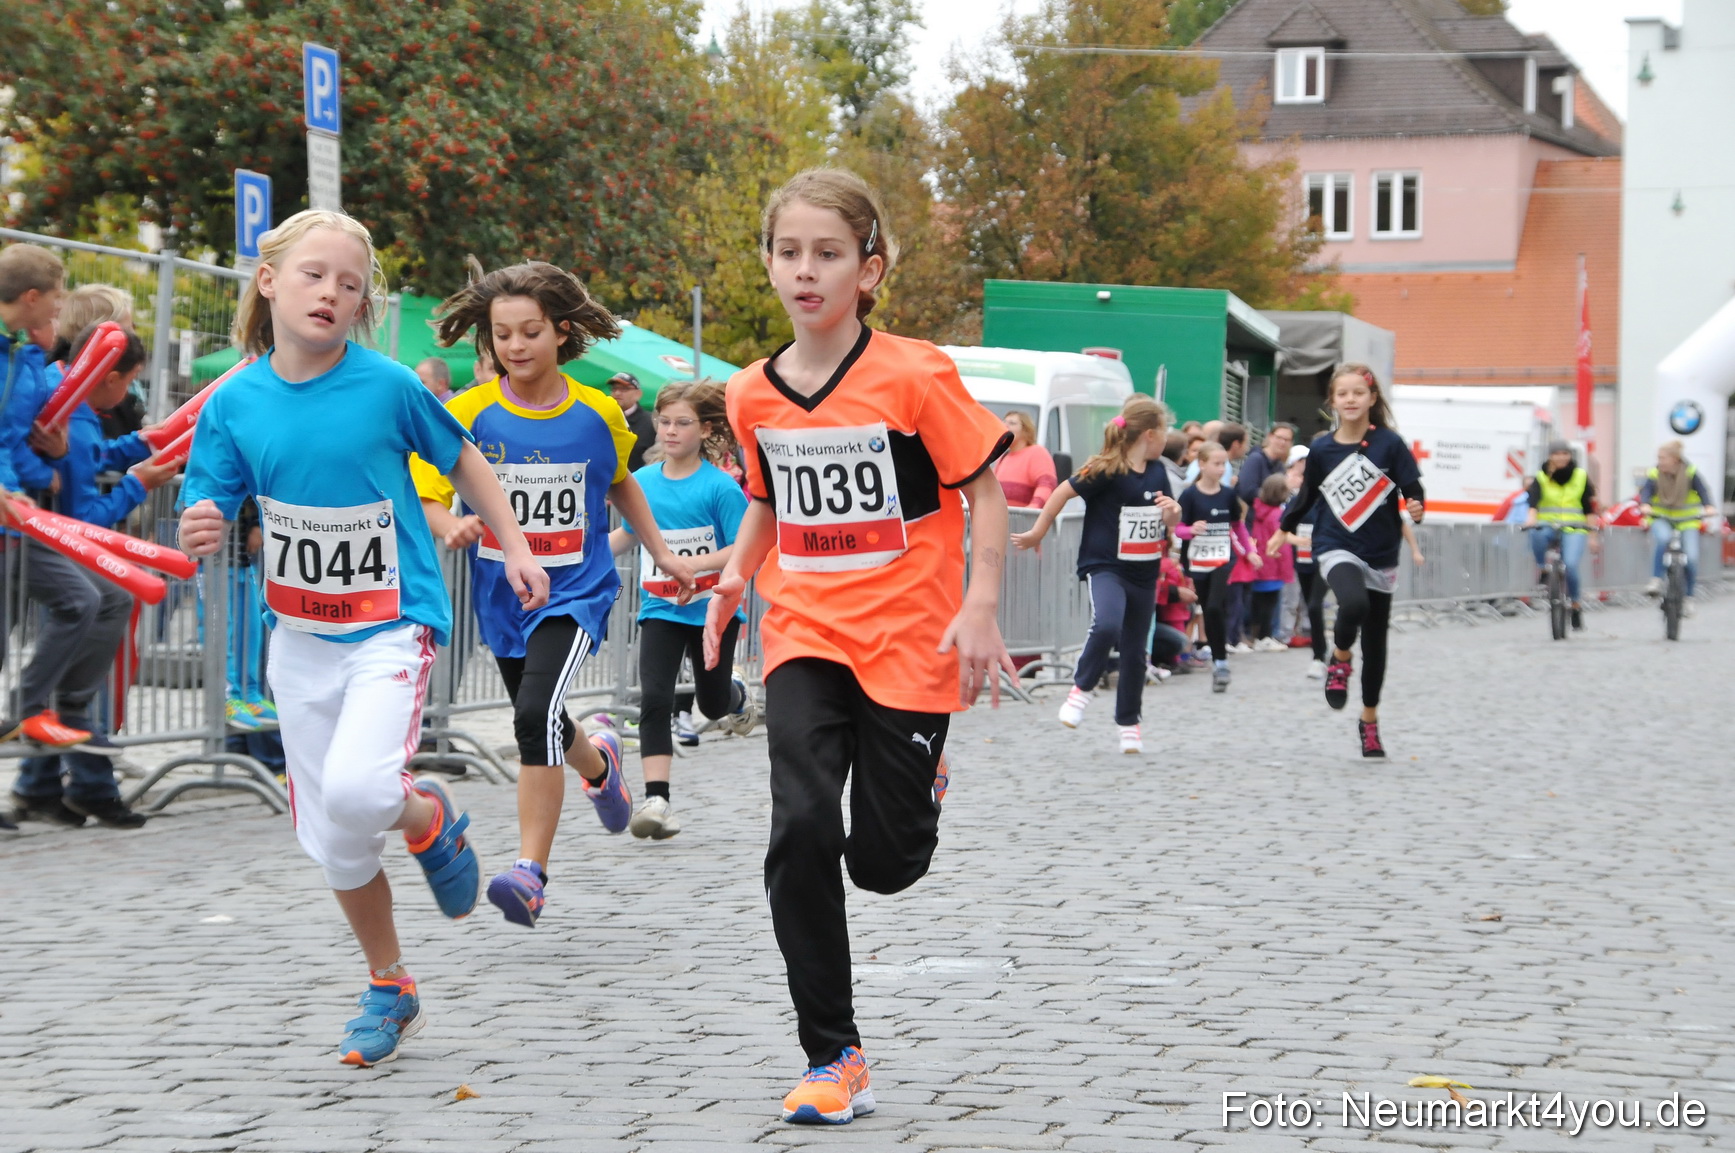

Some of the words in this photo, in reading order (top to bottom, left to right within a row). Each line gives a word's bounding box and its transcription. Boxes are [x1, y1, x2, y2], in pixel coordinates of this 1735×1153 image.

[312, 56, 333, 120] P
[243, 183, 264, 248] P
[763, 442, 793, 457] PARTL
[796, 442, 863, 457] Neumarkt
[515, 474, 567, 485] Neumarkt
[777, 461, 885, 517] 7039
[1332, 464, 1375, 510] 7554
[264, 506, 299, 530] PARTL
[302, 518, 371, 533] Neumarkt
[504, 488, 576, 527] 049
[26, 516, 59, 538] Audi
[59, 533, 89, 556] BKK
[84, 527, 113, 545] BKK
[664, 535, 701, 546] Neumarkt
[803, 530, 857, 552] Marie
[271, 530, 387, 586] 7044
[1193, 544, 1226, 558] 7515
[301, 595, 353, 619] Larah
